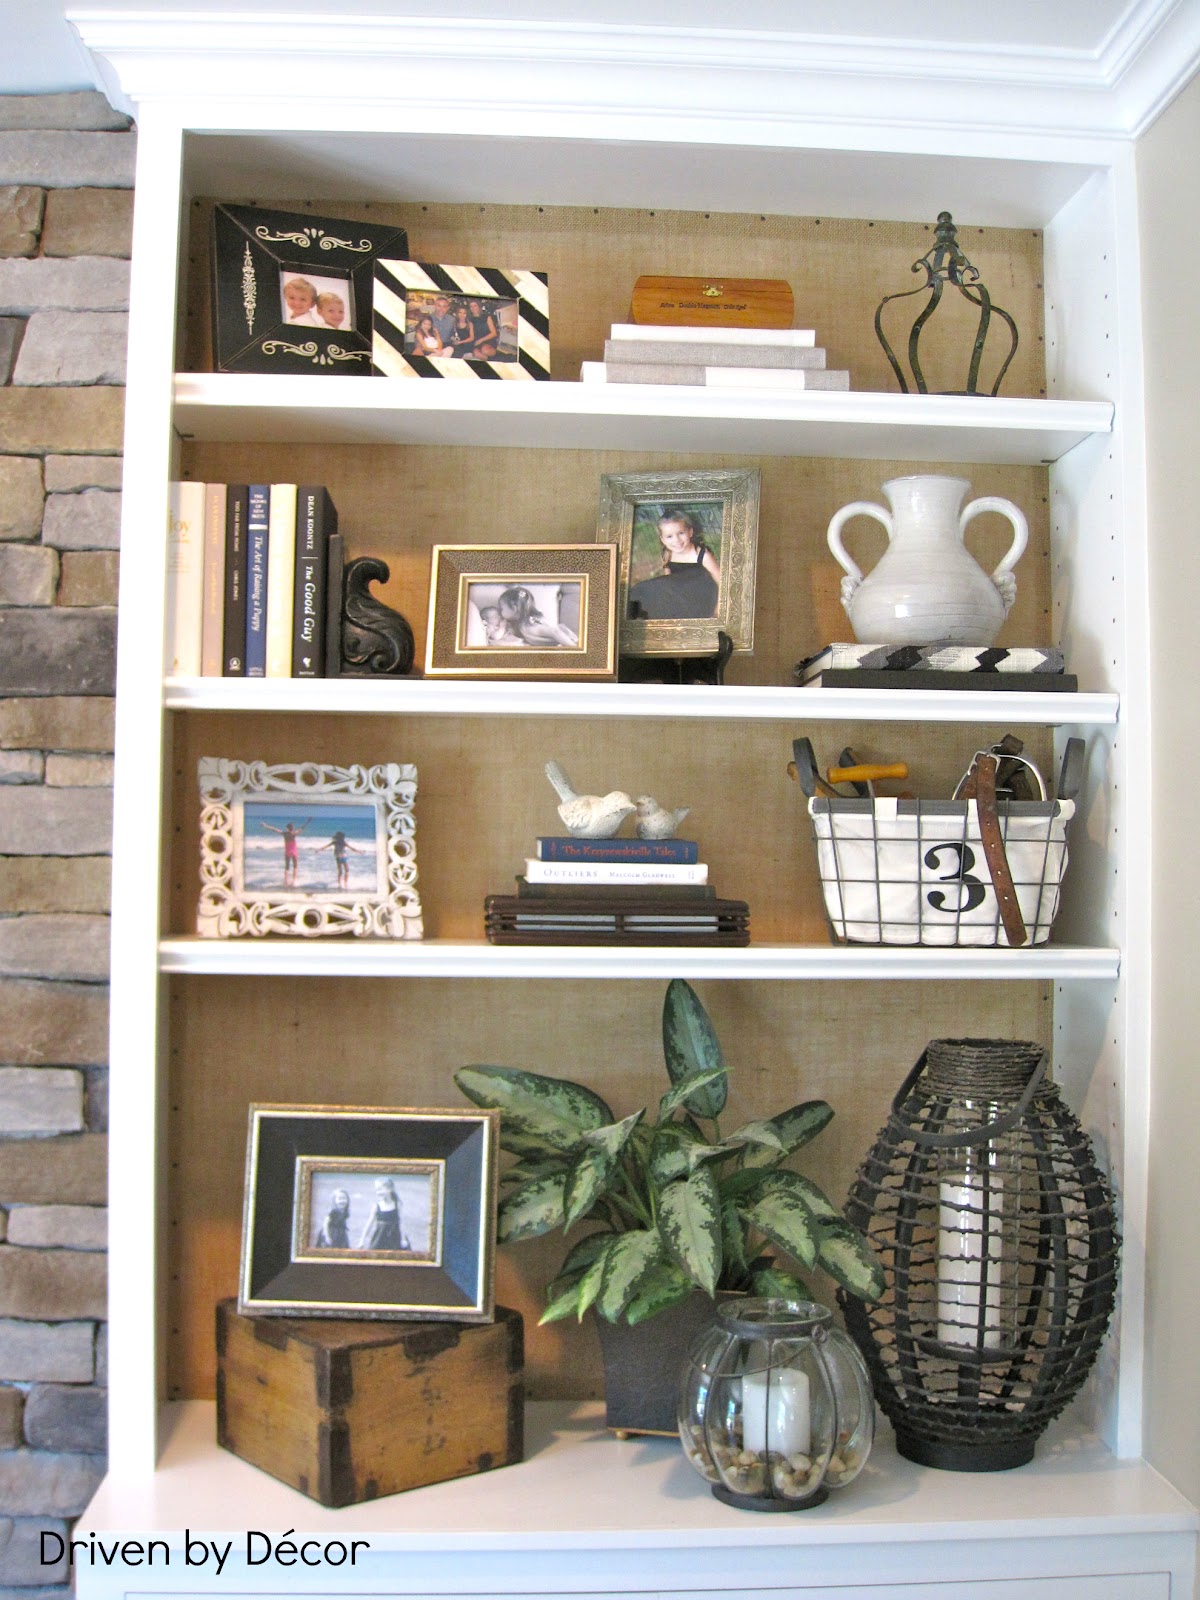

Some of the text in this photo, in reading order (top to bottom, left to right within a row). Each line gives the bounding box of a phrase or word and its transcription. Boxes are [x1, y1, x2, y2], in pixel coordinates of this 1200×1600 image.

[306, 495, 315, 550] DEAN KOONTZ
[254, 535, 264, 550] The
[253, 550, 263, 564] Art
[251, 564, 263, 572] of
[251, 573, 263, 600] Raising
[301, 565, 316, 642] The Good Guy
[250, 607, 262, 632] Puppy
[562, 845, 581, 856] The
[653, 846, 677, 857] Tales
[543, 868, 598, 878] OUTLIERS
[609, 871, 676, 879] MALCOLM GLADWELL
[924, 842, 985, 912] 3
